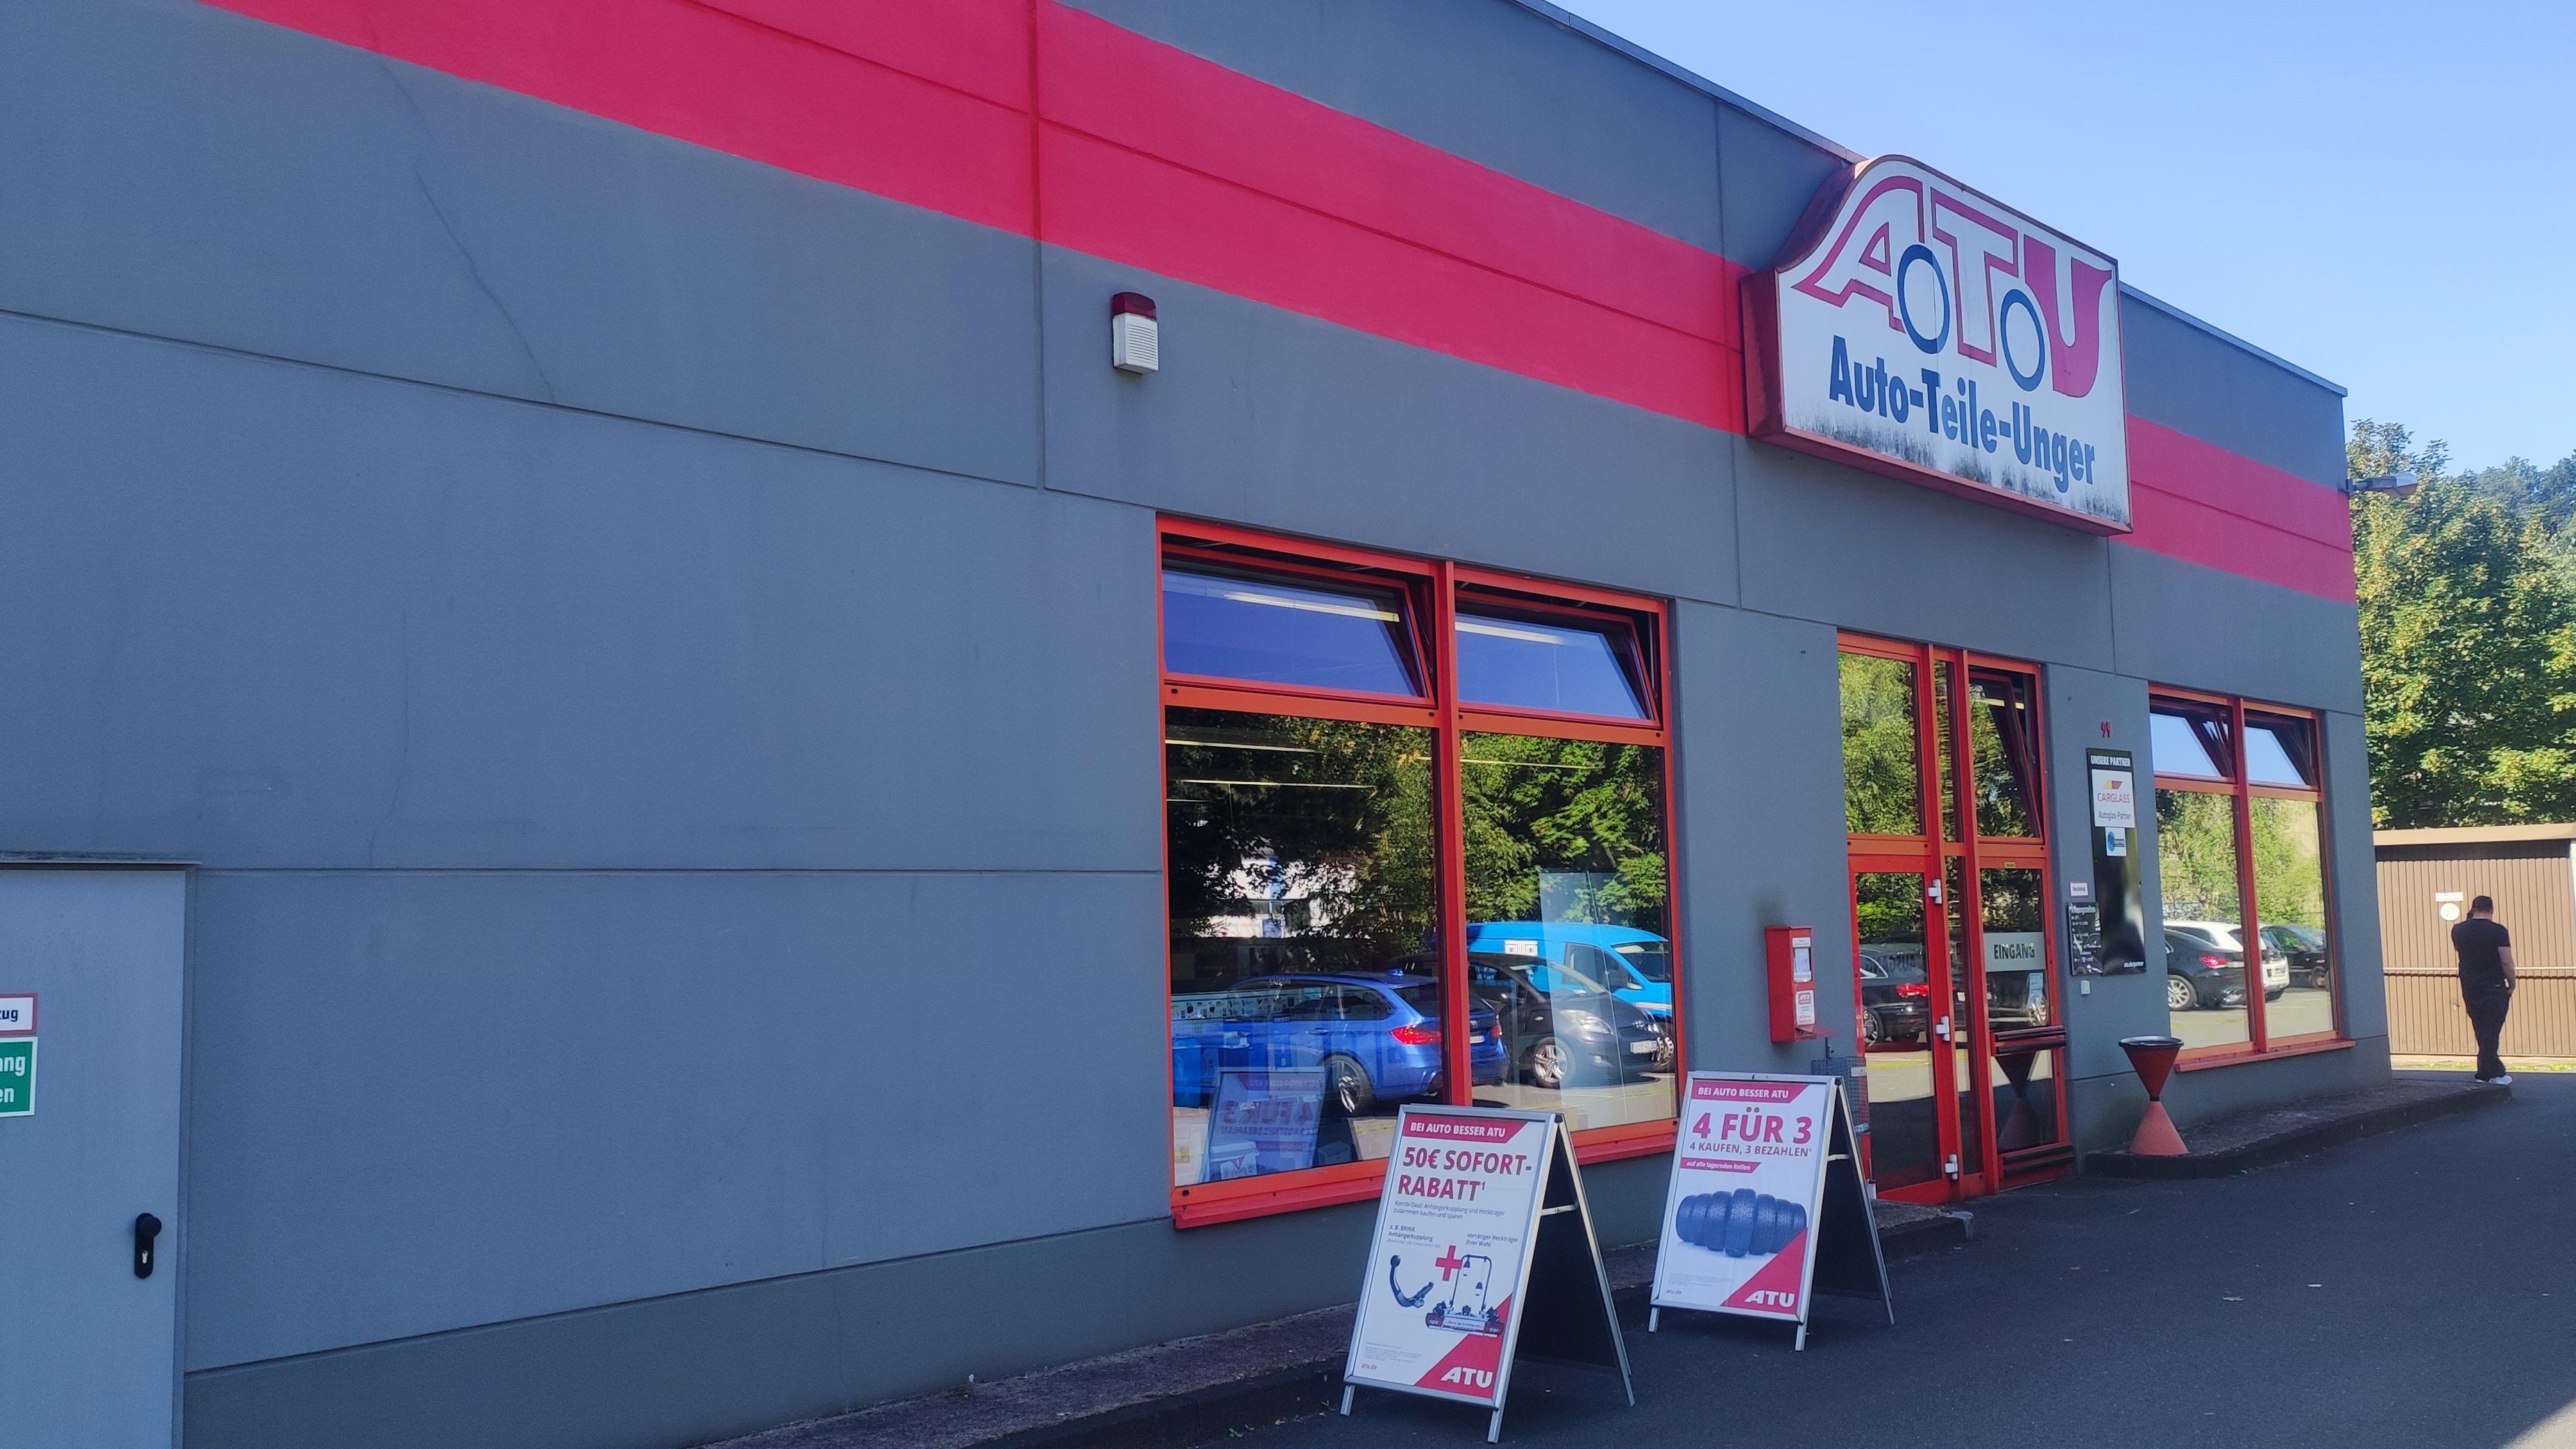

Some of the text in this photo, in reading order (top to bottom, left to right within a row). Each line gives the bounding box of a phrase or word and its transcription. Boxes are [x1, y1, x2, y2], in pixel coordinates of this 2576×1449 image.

[1829, 335, 2096, 493] Auto-Teile-Unger
[2090, 755, 2131, 767] UNSERE PARTNER
[2098, 793, 2130, 804] CARGLASS
[1994, 943, 2035, 959] EINGANG
[1698, 1087, 1789, 1099] BEI AUTO BESSER ATU
[1410, 1122, 1506, 1137] BEI AUTO BESSER ATU
[1692, 1106, 1812, 1144] 4 FÜR 3
[1690, 1142, 1696, 1151] 4
[1698, 1142, 1742, 1155] KAUFEN,
[1745, 1145, 1752, 1154] 3
[1403, 1147, 1532, 1176] 50€ SOFORT-
[1744, 1290, 1795, 1307] ATU
[1440, 1366, 1493, 1388] ATU
